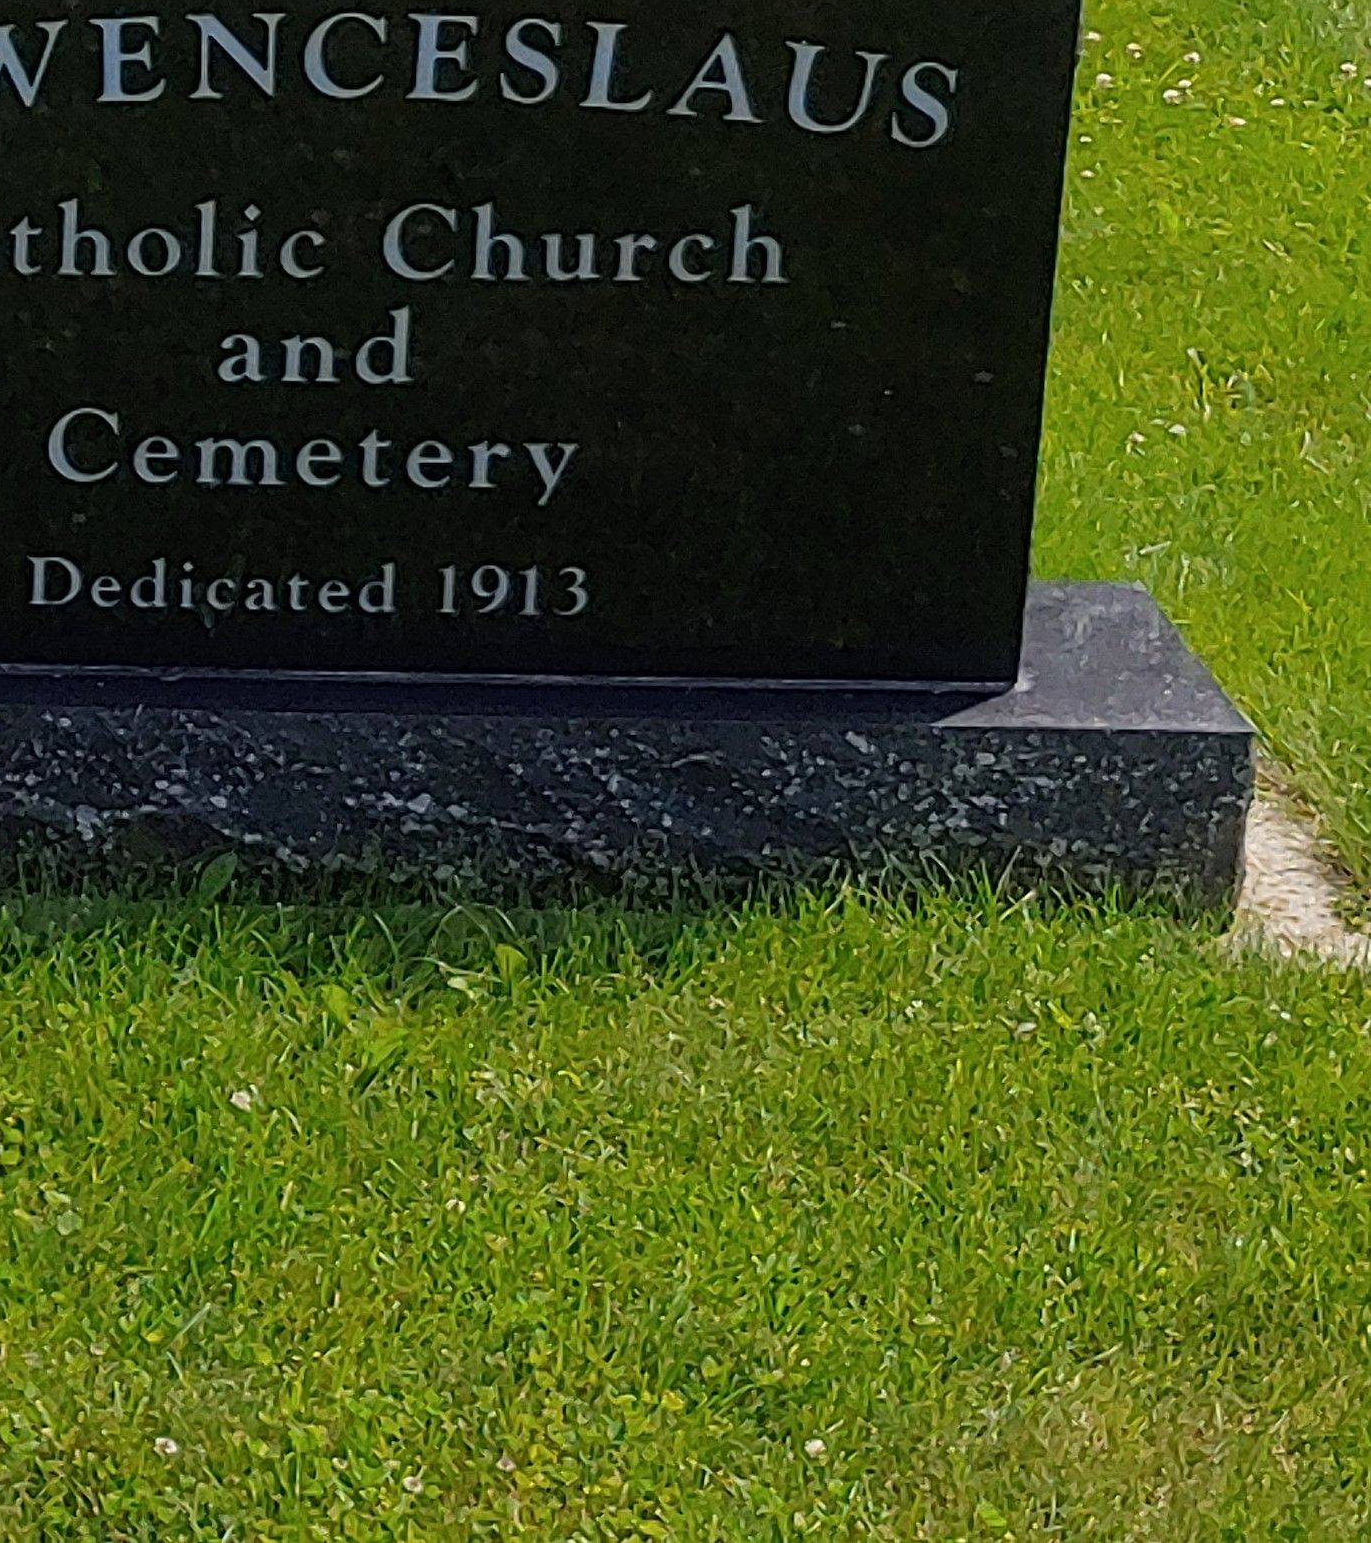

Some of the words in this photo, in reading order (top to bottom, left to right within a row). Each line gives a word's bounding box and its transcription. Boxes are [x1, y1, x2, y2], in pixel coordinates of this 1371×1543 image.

[383, 203, 790, 284] Church
[218, 307, 413, 384] and
[48, 407, 580, 505] Cemetery
[29, 556, 395, 614] Dedicated
[436, 564, 590, 616] 1913
